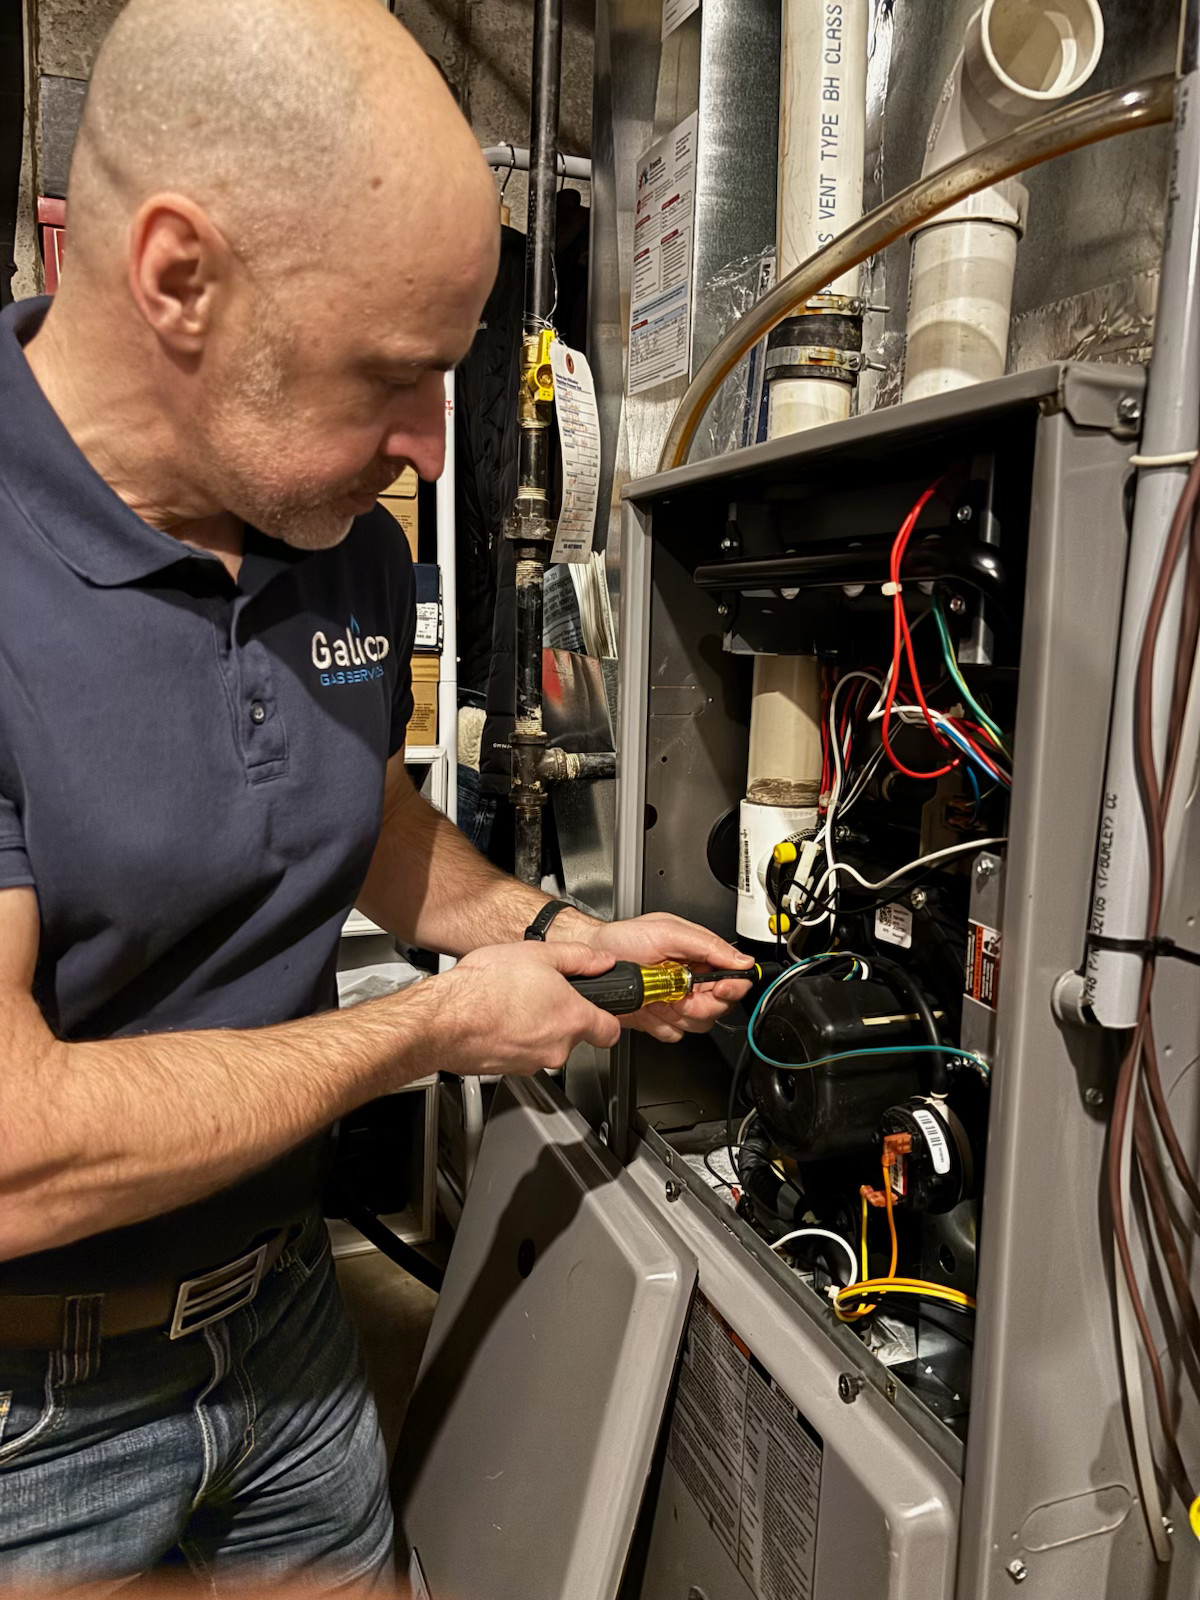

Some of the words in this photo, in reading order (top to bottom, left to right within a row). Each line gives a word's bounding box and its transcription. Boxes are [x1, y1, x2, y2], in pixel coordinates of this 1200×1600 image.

[824, 4, 842, 64] CLASS
[822, 77, 840, 101] BH
[820, 114, 839, 161] TYPE
[819, 173, 837, 220] VENT
[320, 671, 346, 687] GAS
